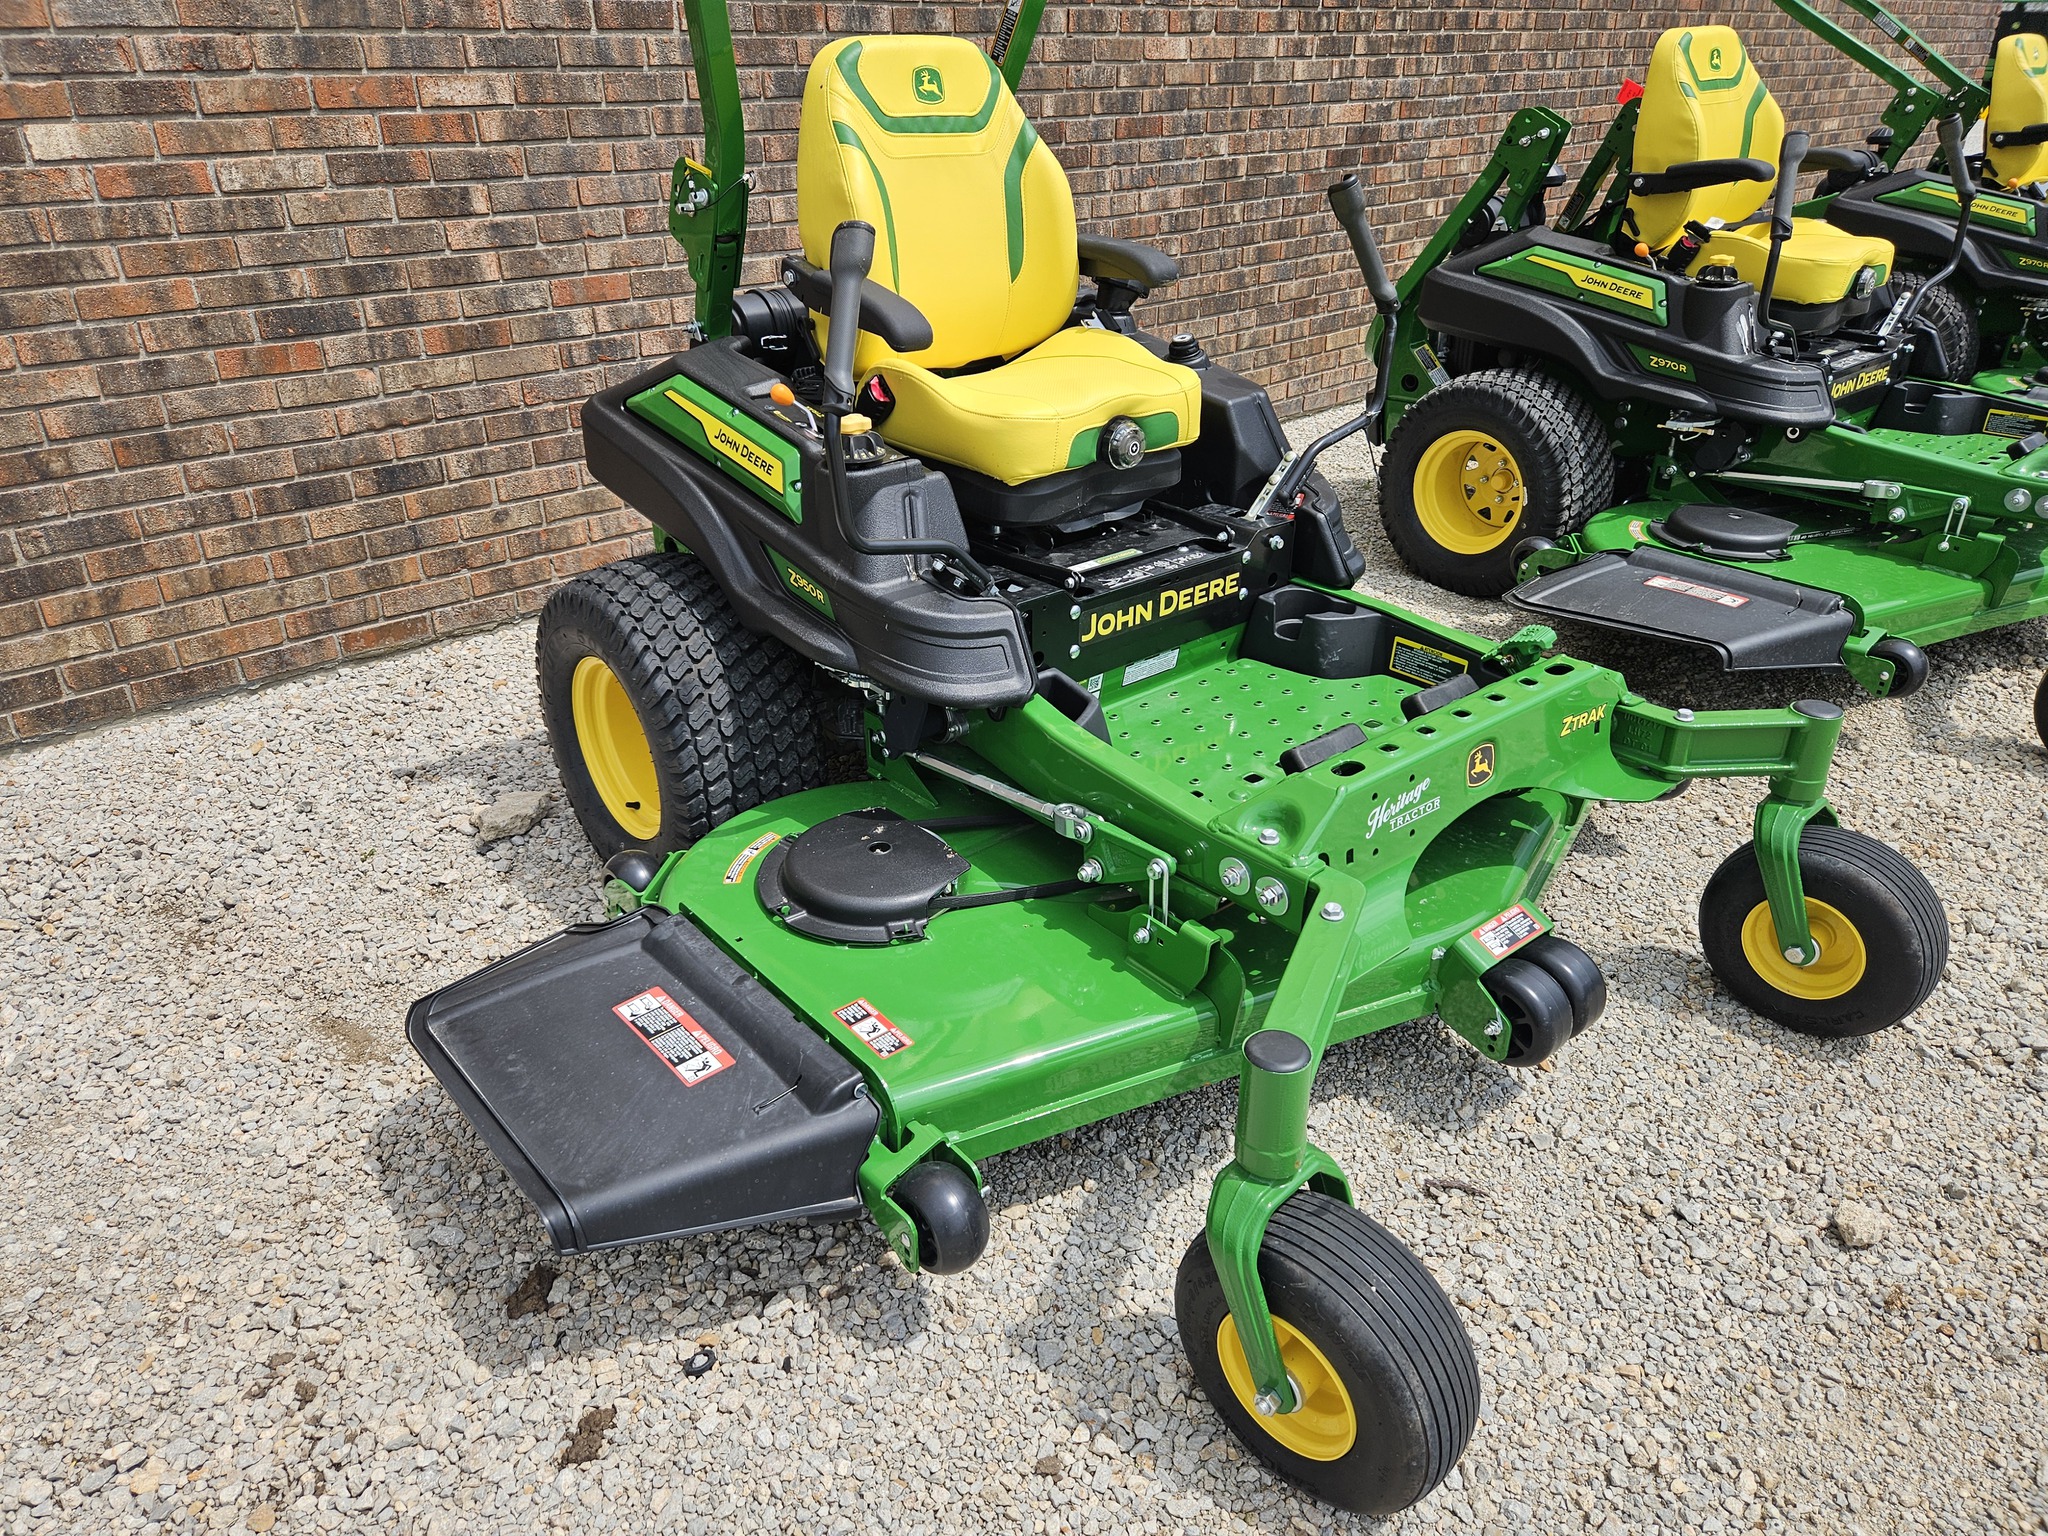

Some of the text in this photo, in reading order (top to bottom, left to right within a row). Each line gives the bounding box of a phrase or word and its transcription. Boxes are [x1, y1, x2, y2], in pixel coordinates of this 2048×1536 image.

[1970, 202, 2019, 218] OHN DEERE
[1581, 275, 1644, 300] JOHN DEERE
[1649, 355, 1687, 373] Z970R
[1856, 366, 1890, 390] DEERE
[714, 428, 775, 477] JOHN DEERE
[787, 567, 825, 605] Z950R
[1081, 572, 1240, 642] JOHN DEERE
[1560, 702, 1608, 737] ZTRAK
[1365, 777, 1431, 839] Heritage
[1389, 798, 1441, 831] TRACTOR
[661, 998, 684, 1018] DANGER
[698, 1033, 723, 1055] PELIGRO
